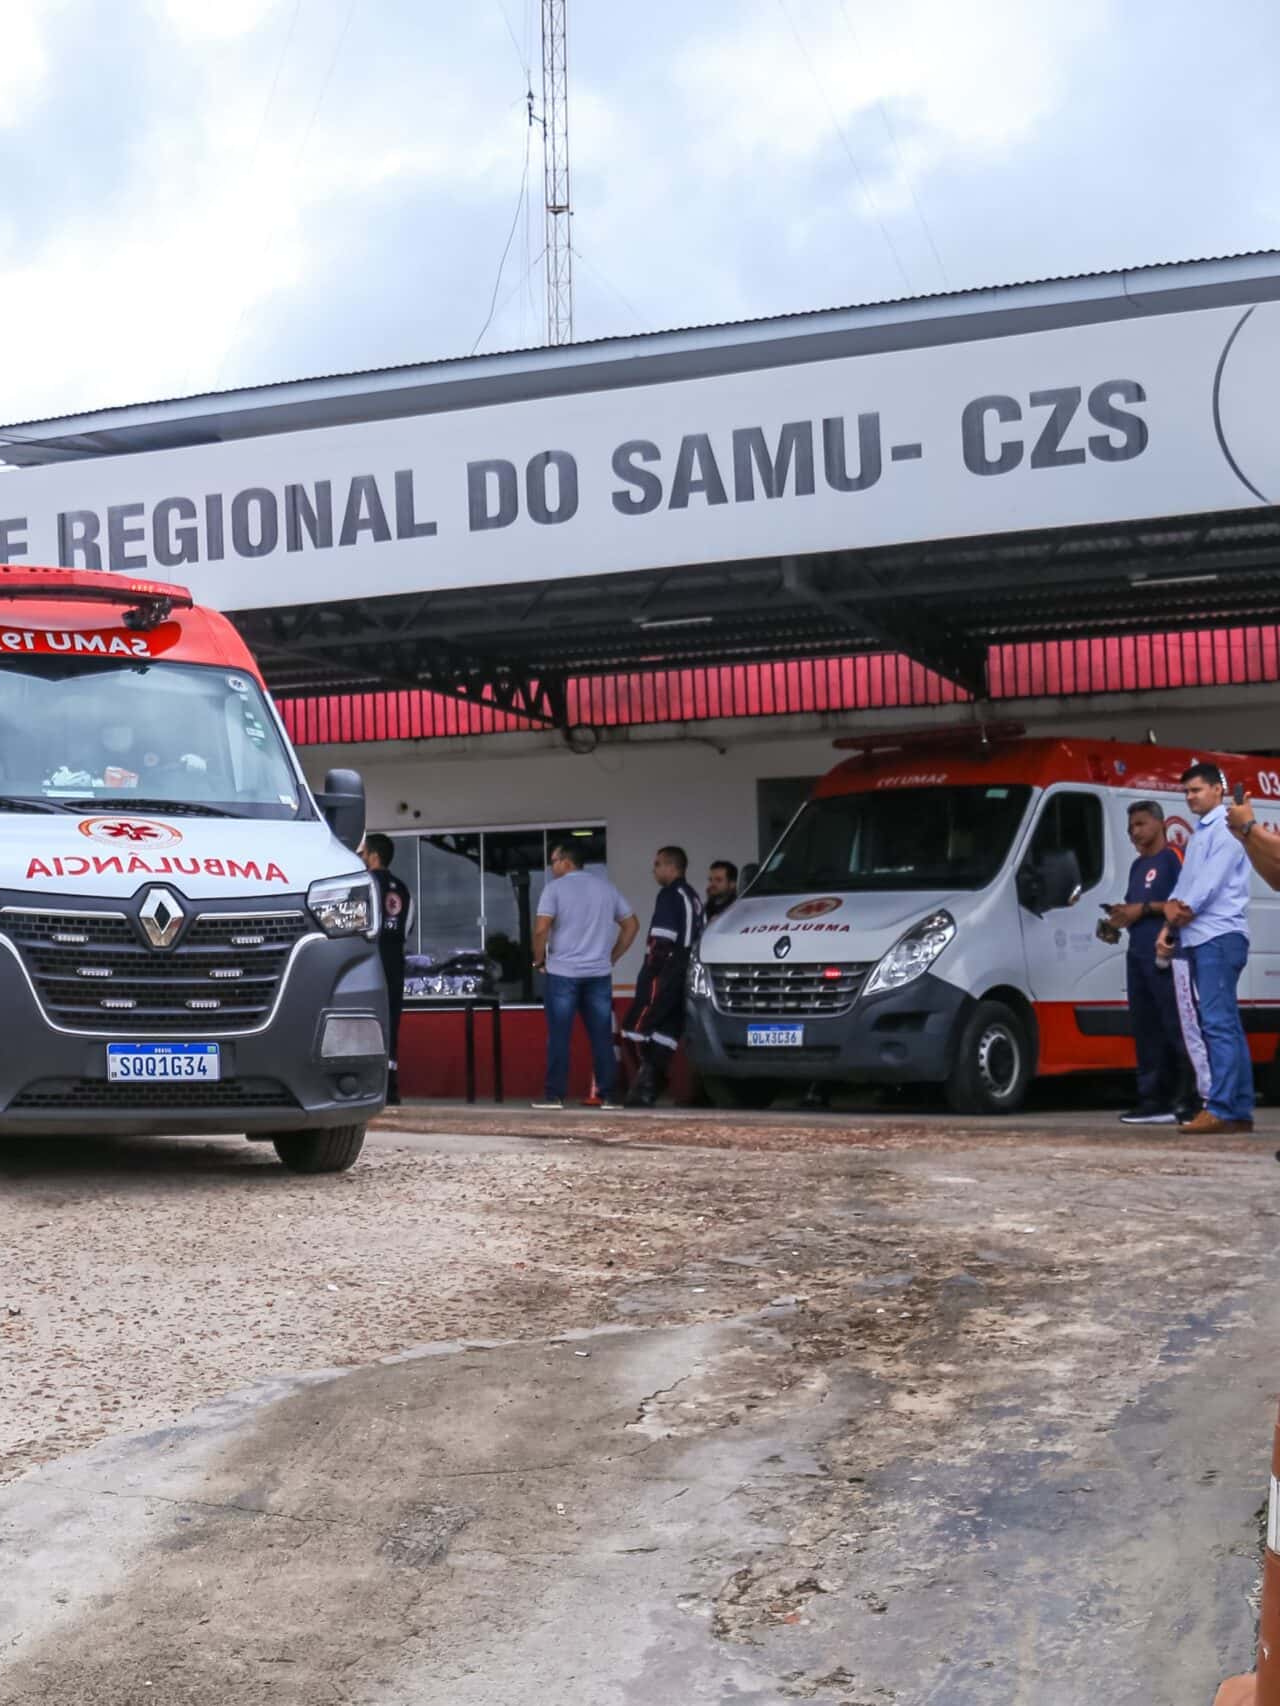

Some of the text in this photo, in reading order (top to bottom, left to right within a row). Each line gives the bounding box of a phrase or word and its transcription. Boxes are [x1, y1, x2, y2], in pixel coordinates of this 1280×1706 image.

[56, 468, 438, 571] REGIONAL
[466, 449, 579, 532] DO
[961, 378, 1149, 476] CZS
[119, 1056, 208, 1077] SQQ1G34
